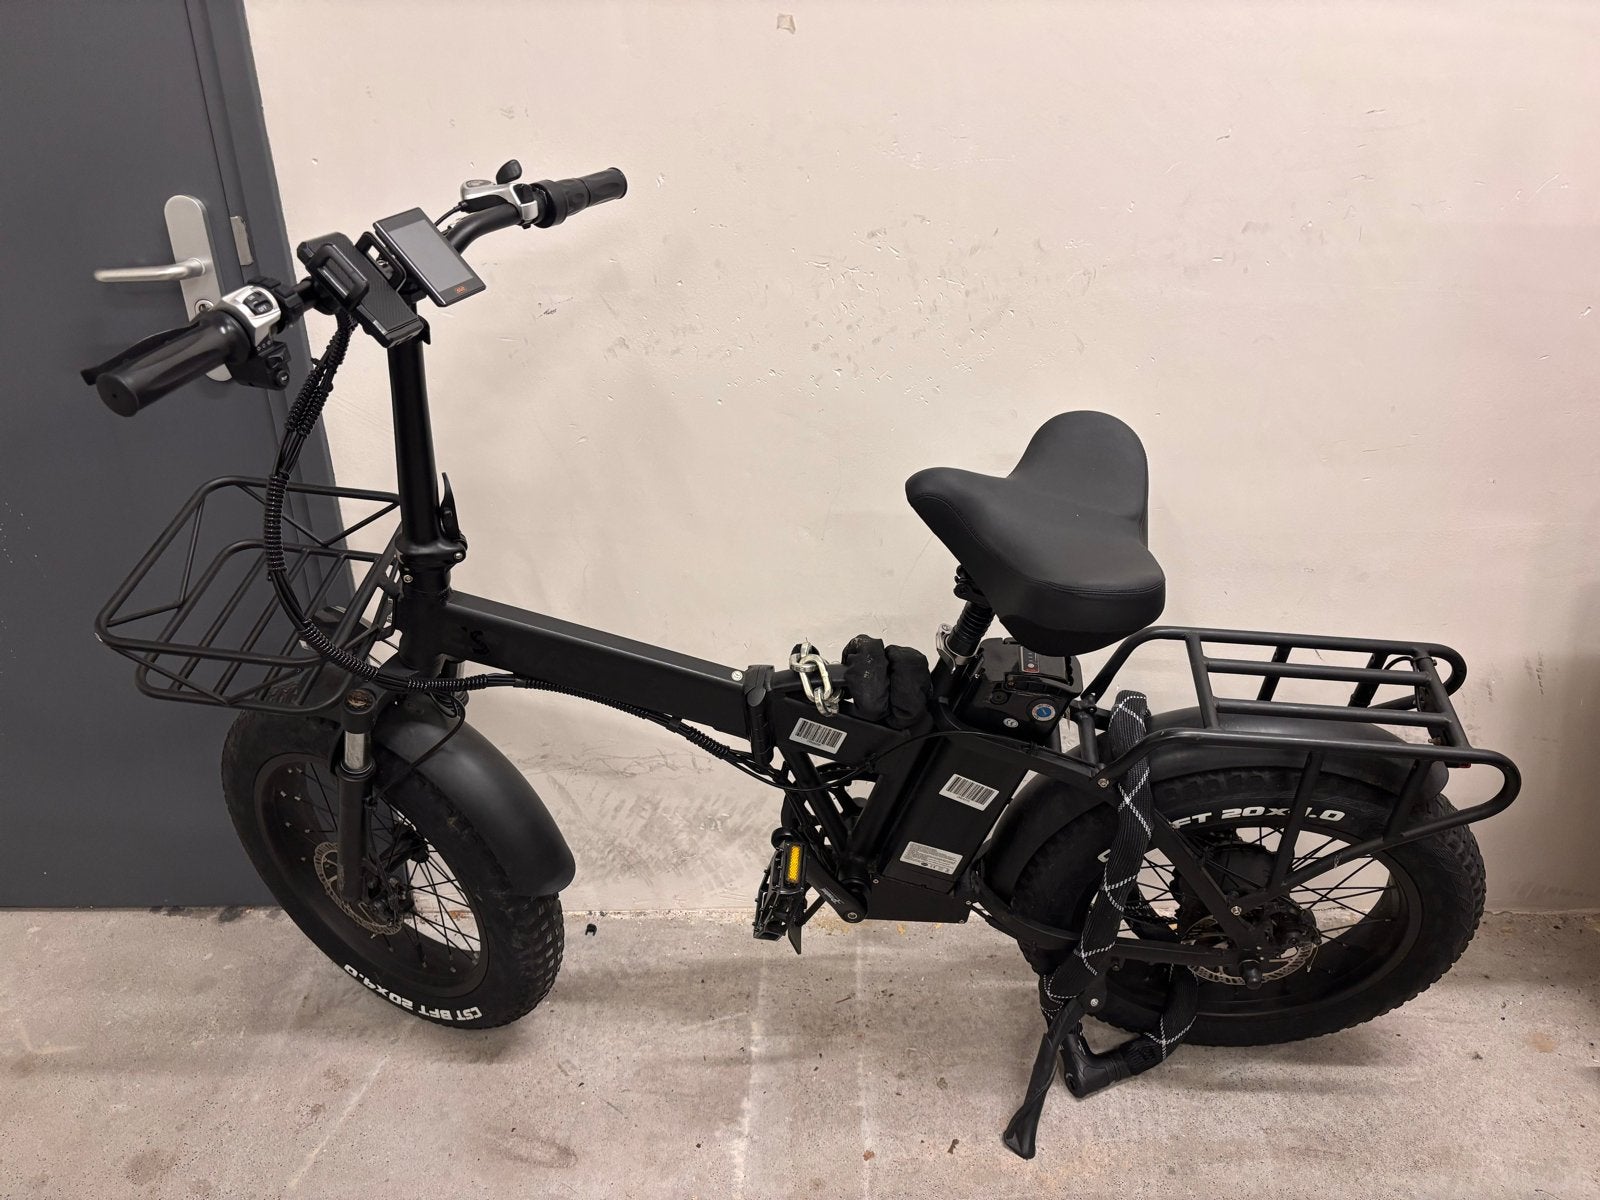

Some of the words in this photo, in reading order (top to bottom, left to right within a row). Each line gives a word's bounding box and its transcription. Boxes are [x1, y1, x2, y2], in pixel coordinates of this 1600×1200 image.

[258, 305, 268, 313] OFF
[1168, 811, 1213, 830] FT
[343, 964, 414, 1011] 20x4.0
[418, 1005, 453, 1021] BFT
[457, 1006, 483, 1021] CST
